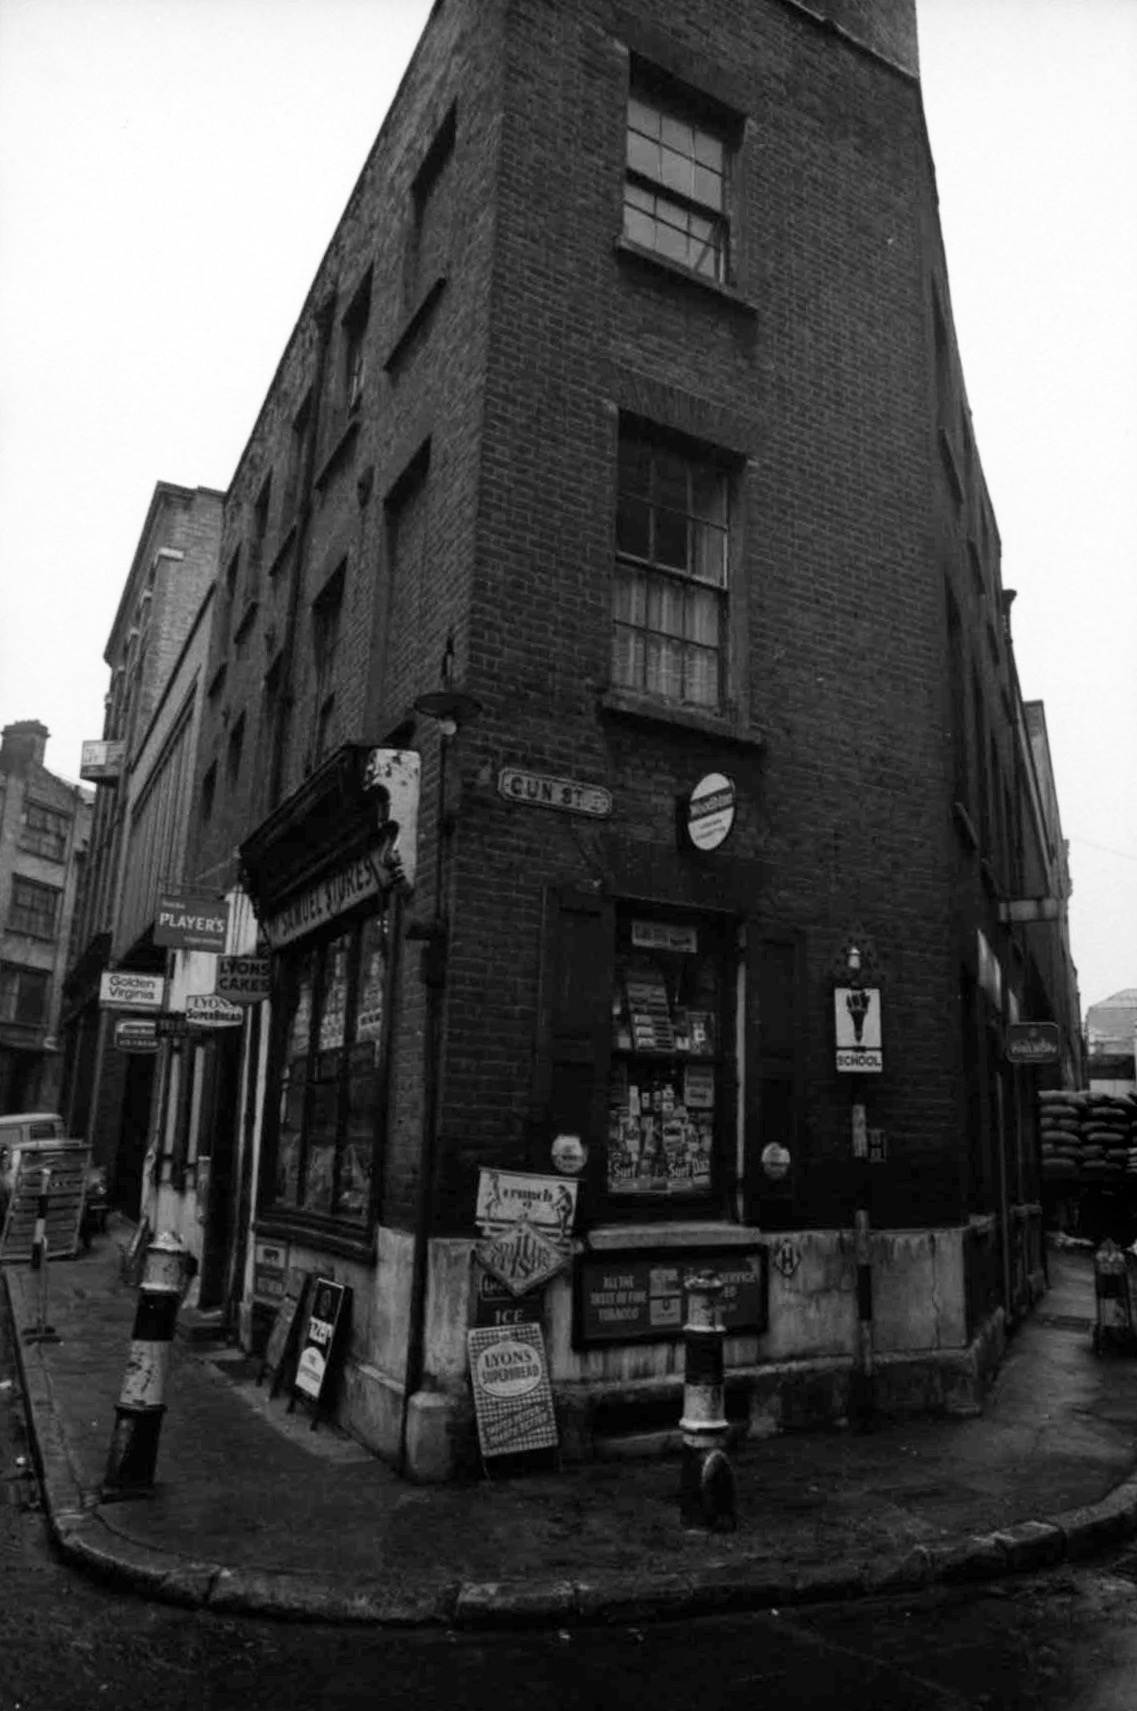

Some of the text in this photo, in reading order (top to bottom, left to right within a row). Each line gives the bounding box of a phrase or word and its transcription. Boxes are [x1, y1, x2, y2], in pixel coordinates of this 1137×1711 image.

[511, 776, 552, 801] GUN
[561, 787, 583, 806] ST
[159, 912, 224, 933] PLAYER'S
[220, 961, 271, 976] LYONS
[109, 975, 156, 990] Golden
[219, 977, 271, 992] CAKES
[108, 986, 155, 1003] Virginia
[837, 1055, 882, 1067] SCHOOL
[781, 1247, 794, 1271] H
[495, 1309, 524, 1323] ICE
[484, 1349, 533, 1368] LYONS
[481, 1365, 539, 1384] SUPERBREAD
